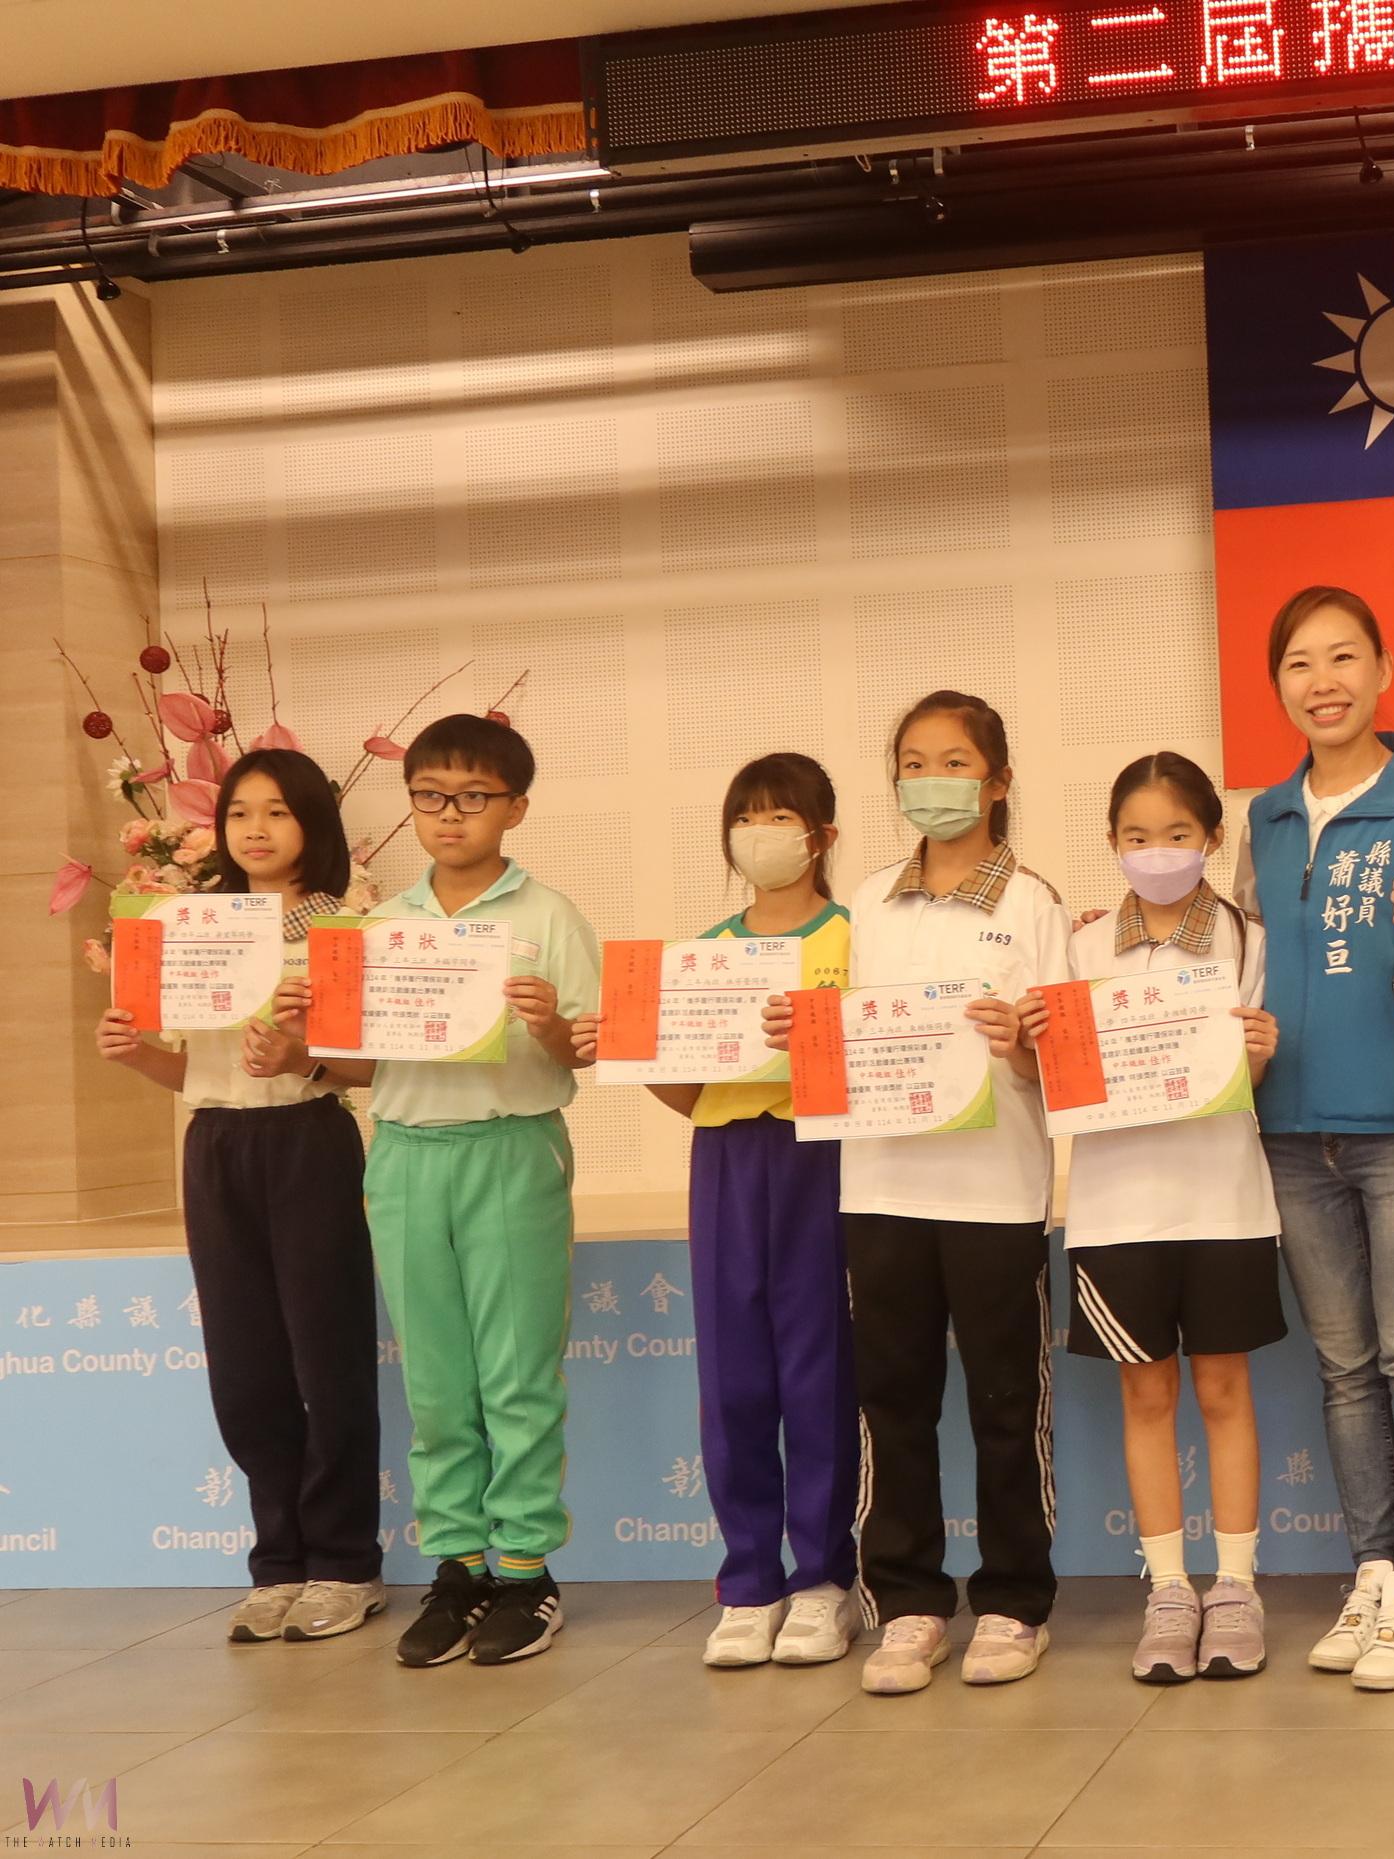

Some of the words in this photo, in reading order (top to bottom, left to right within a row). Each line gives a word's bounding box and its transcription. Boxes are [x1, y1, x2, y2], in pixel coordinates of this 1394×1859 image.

[1354, 839, 1392, 928] 縣議員
[244, 898, 267, 906] TERF
[176, 907, 219, 925] 獎狀
[469, 924, 496, 933] TERF
[388, 931, 438, 951] 獎狀
[760, 942, 785, 951] TERF
[979, 931, 1012, 946] 1069
[680, 953, 730, 972] 獎狀
[1192, 966, 1219, 978] TERF
[938, 983, 966, 994] TERF
[1112, 986, 1165, 1011] 獎狀
[862, 999, 911, 1021] 獎狀
[62, 1349, 157, 1377] County
[152, 1524, 258, 1556] Changh
